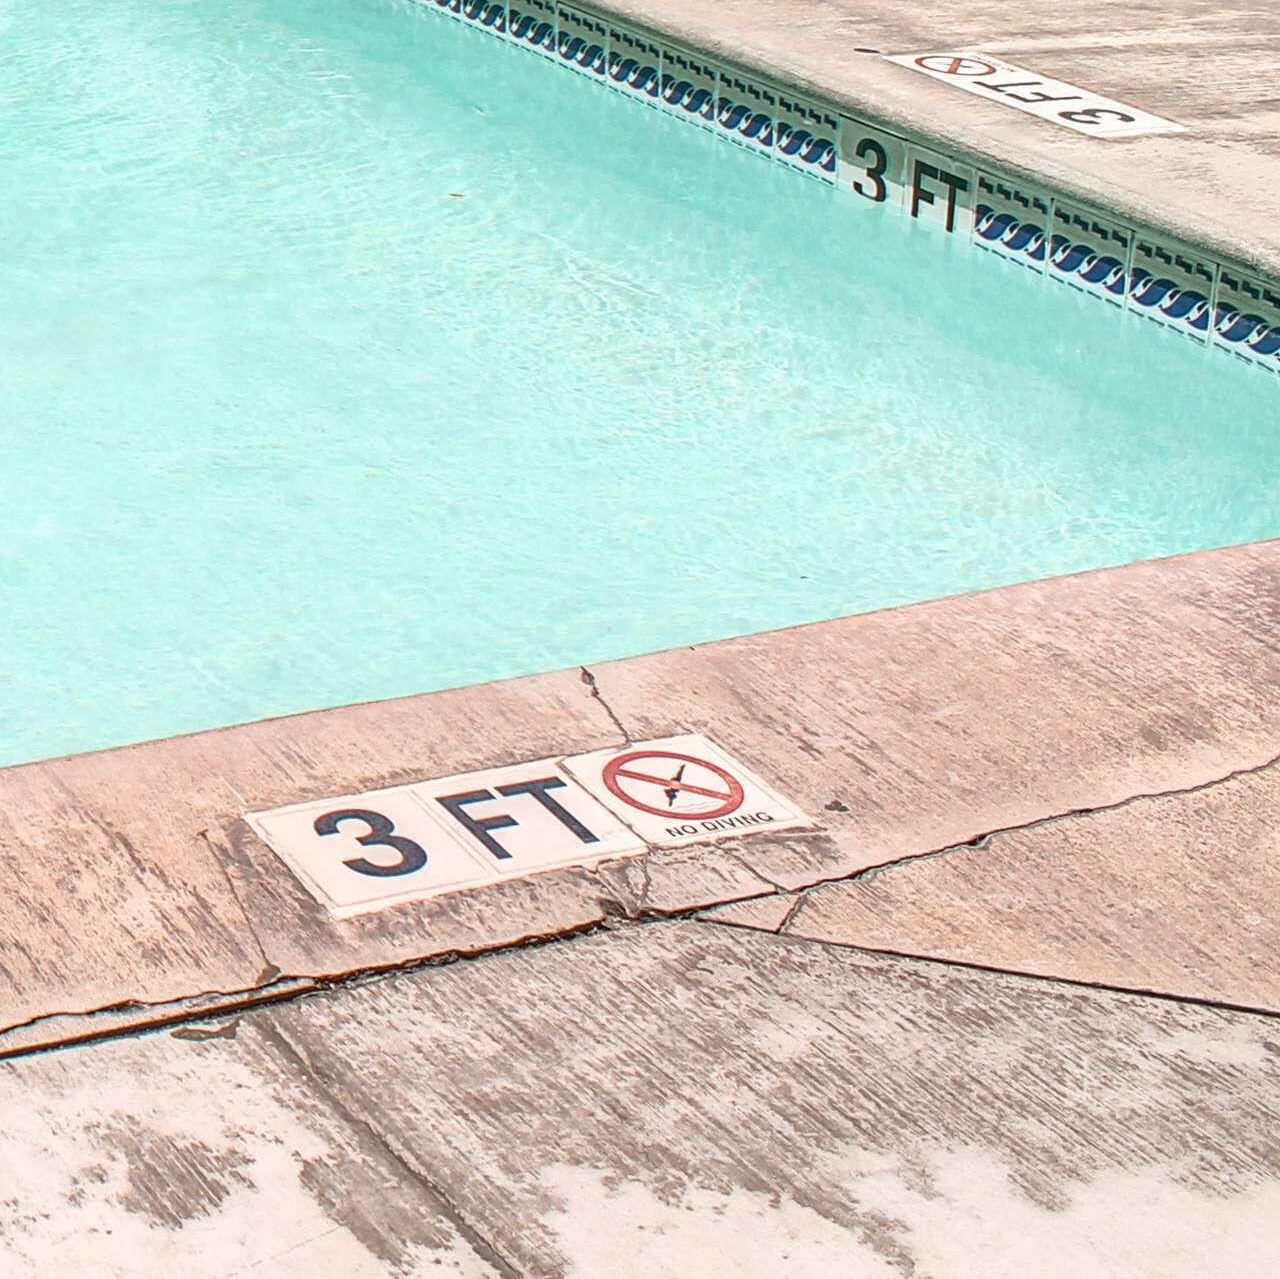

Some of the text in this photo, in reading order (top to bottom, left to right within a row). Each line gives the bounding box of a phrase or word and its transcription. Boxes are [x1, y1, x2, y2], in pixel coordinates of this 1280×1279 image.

[973, 80, 1136, 126] 3 FT
[852, 137, 969, 233] 3 FT
[312, 775, 775, 878] 3 FT NO DIVING
